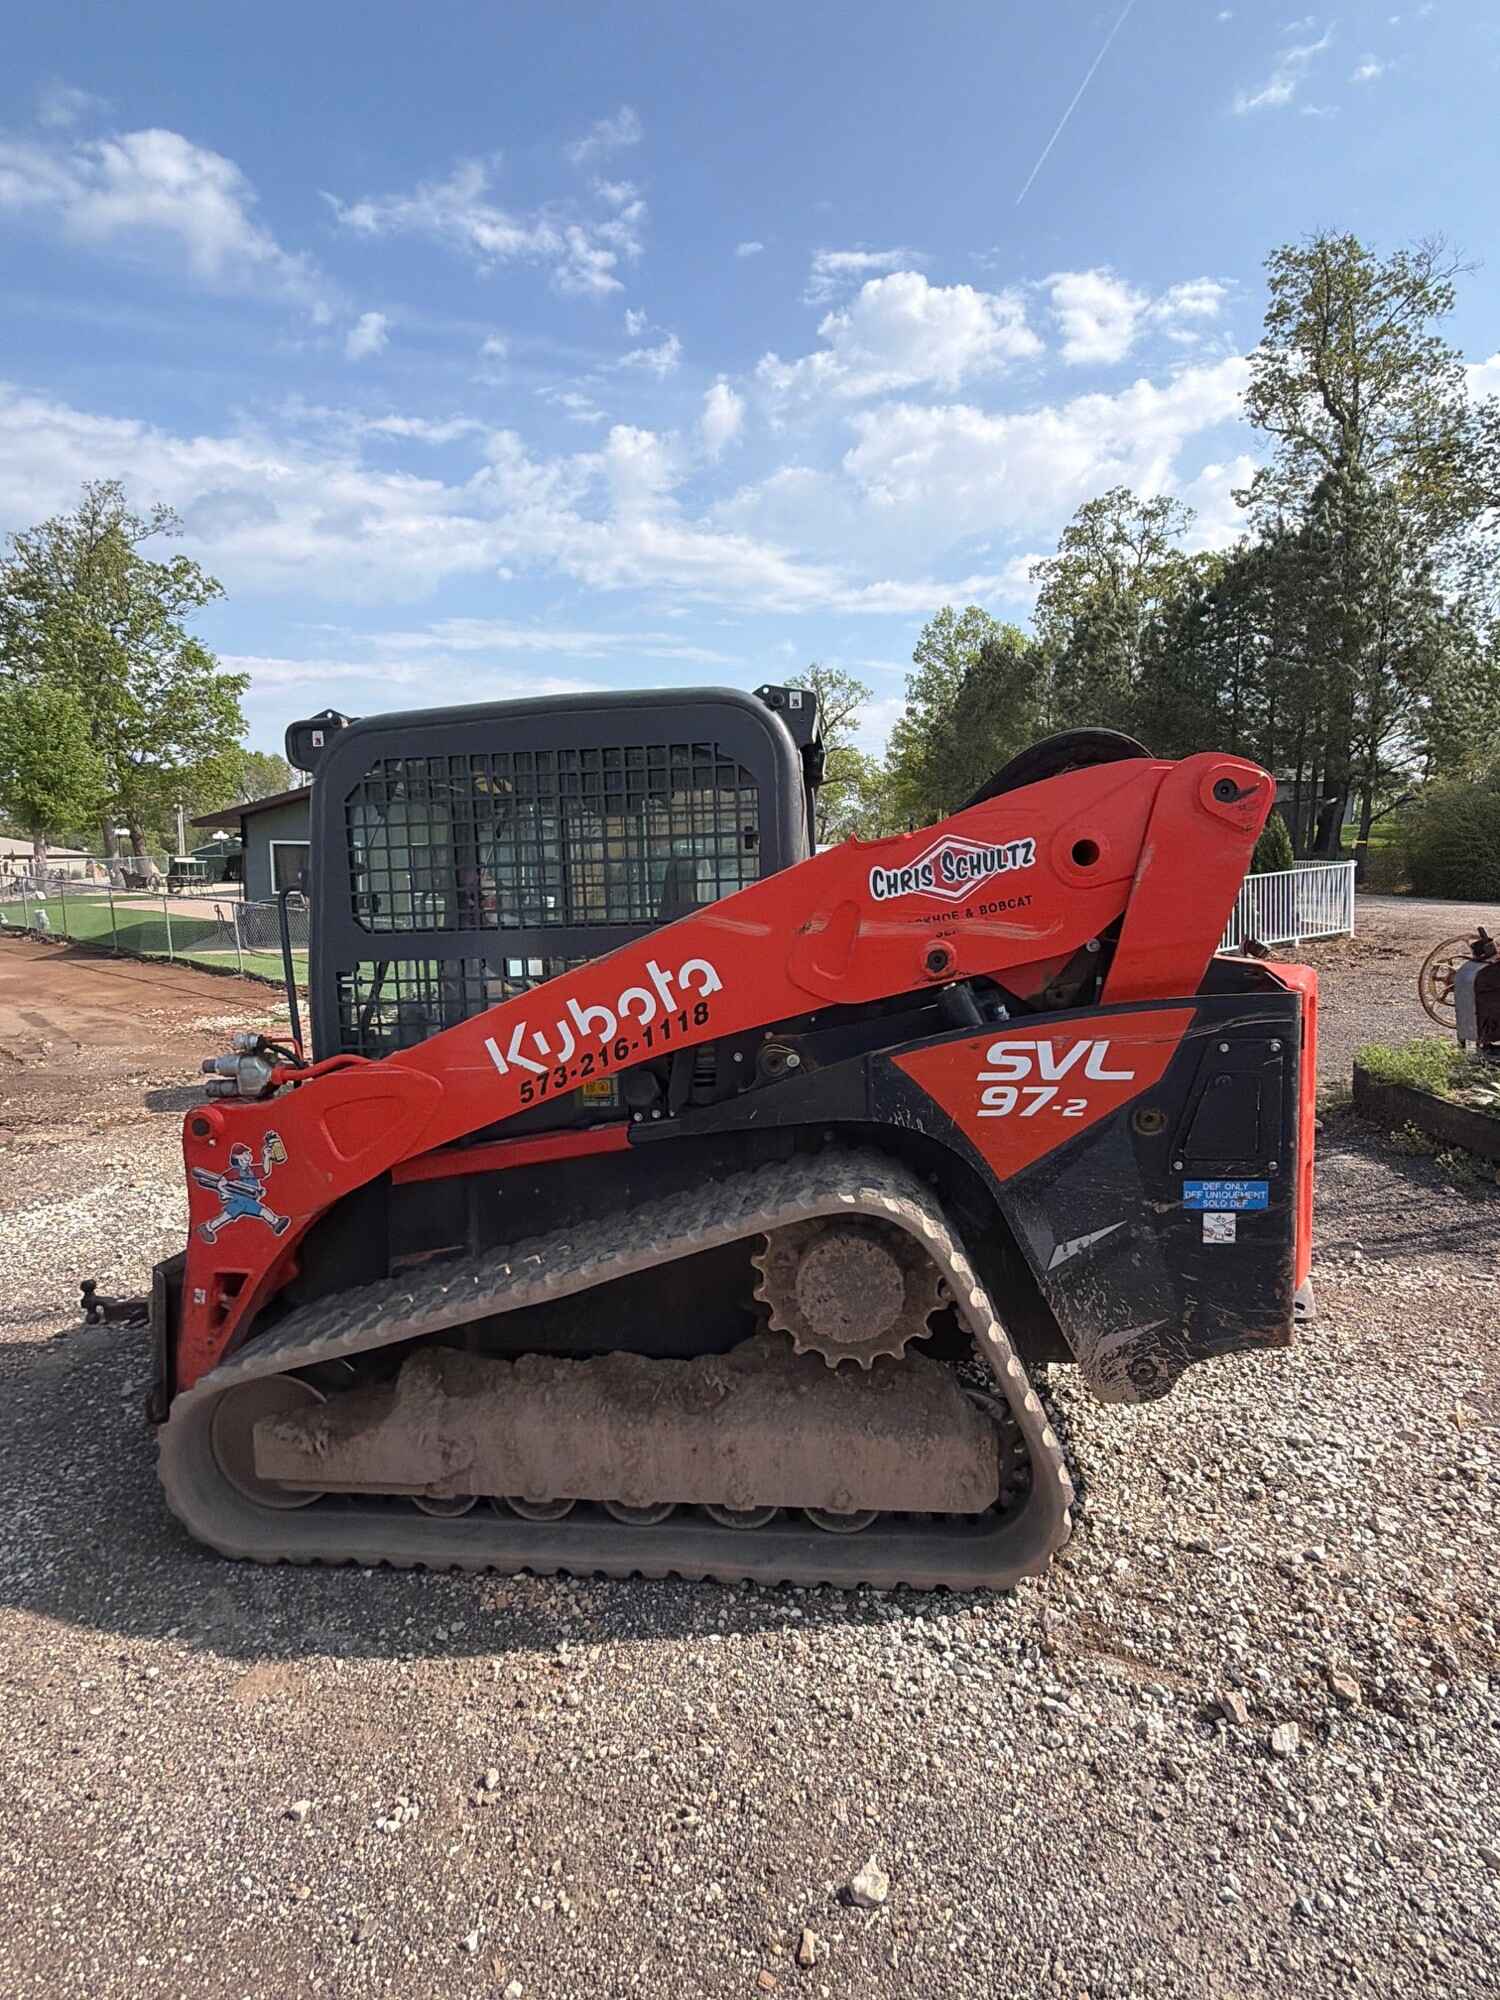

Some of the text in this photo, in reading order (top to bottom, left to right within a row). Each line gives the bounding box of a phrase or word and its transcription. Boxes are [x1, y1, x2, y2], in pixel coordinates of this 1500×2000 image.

[872, 841, 1033, 898] CHRIS SCHULTZ
[965, 908, 974, 919] &
[979, 895, 1033, 915] BOBCAT
[484, 958, 723, 1075] Kubota
[520, 1002, 709, 1103] 573-216-1118
[976, 1040, 1136, 1082] SVL
[977, 1086, 1088, 1117] 97-2
[1184, 1190, 1266, 1199] DEF UNIQUEMENT
[1202, 1182, 1249, 1190] DEF ONLY
[1229, 1200, 1249, 1208] DEF
